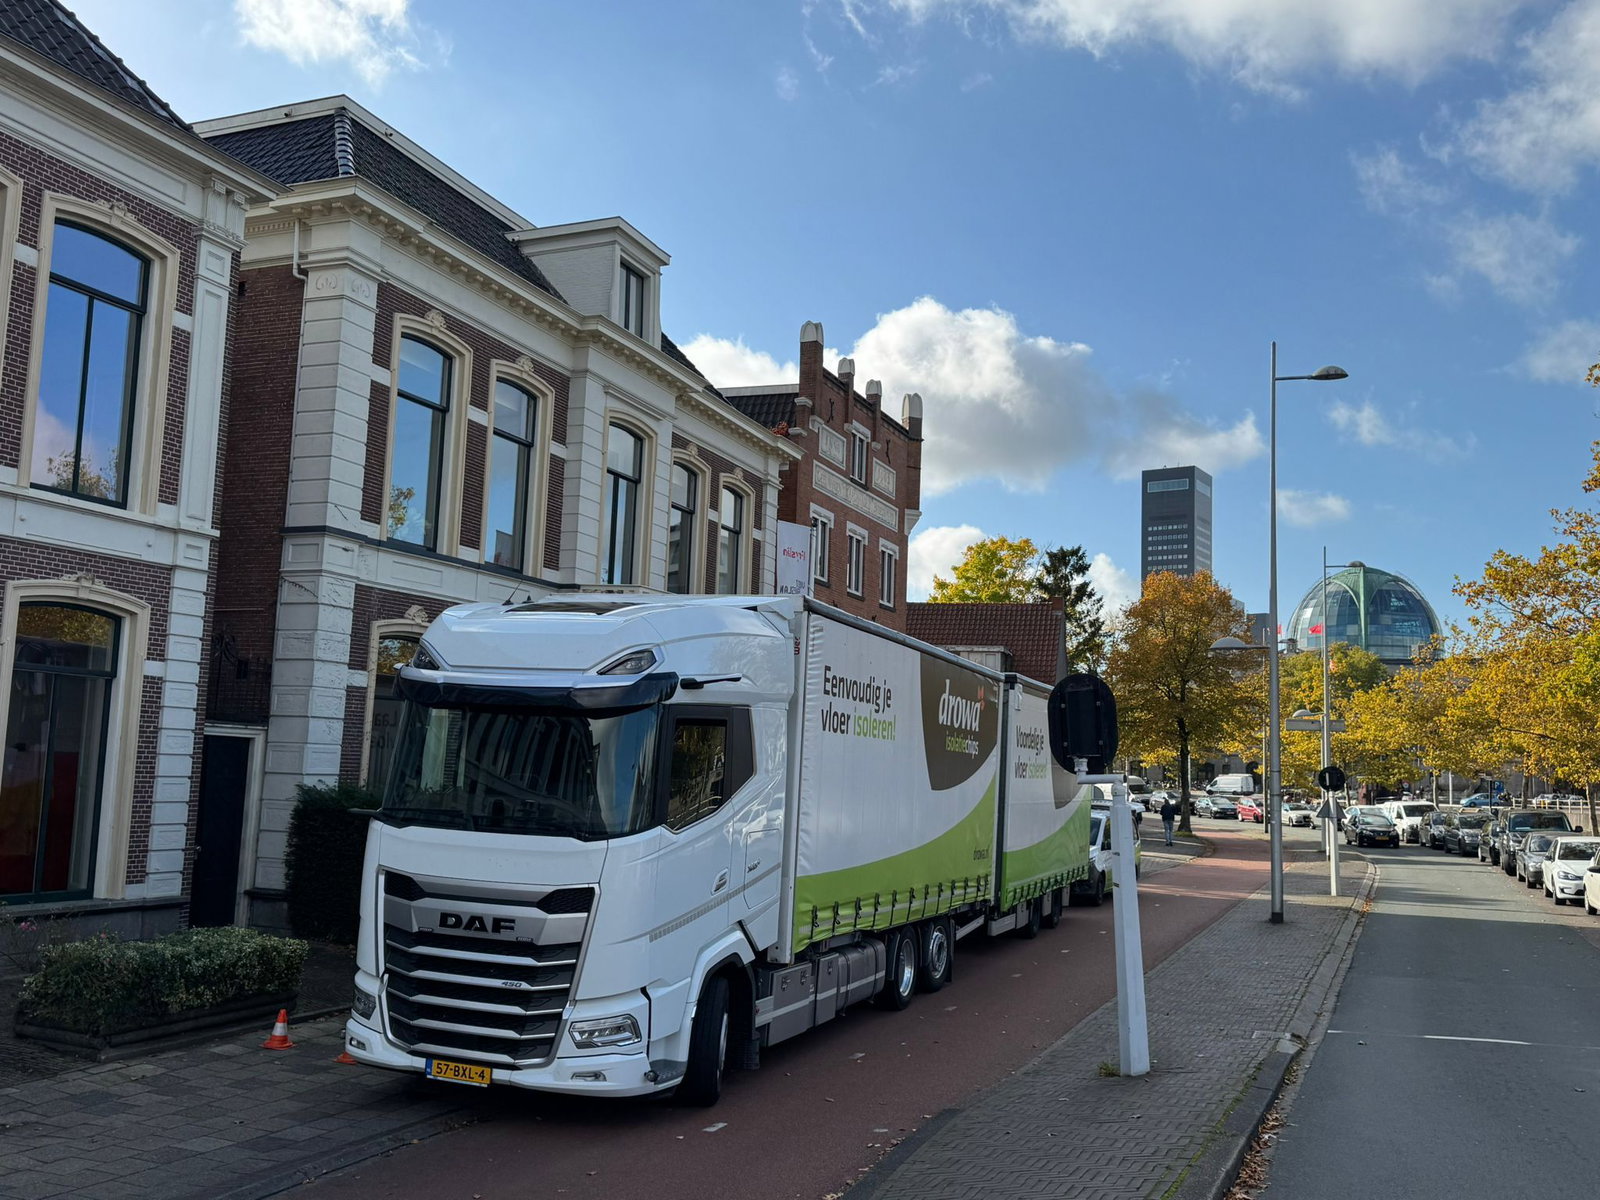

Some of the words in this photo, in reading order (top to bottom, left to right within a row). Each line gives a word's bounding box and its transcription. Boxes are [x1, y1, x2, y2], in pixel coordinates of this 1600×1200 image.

[823, 665, 881, 714] Eenvoudig
[881, 679, 892, 714] je
[821, 701, 851, 735] vloer
[853, 706, 897, 741] isoleren!
[939, 679, 980, 732] drowa
[945, 730, 980, 760] isolatiechips
[1015, 724, 1040, 756] Voordelig
[1039, 728, 1045, 756] je
[1014, 755, 1028, 779] vloer
[438, 911, 516, 934] DAF
[436, 1062, 486, 1082] 57-BXL-4
